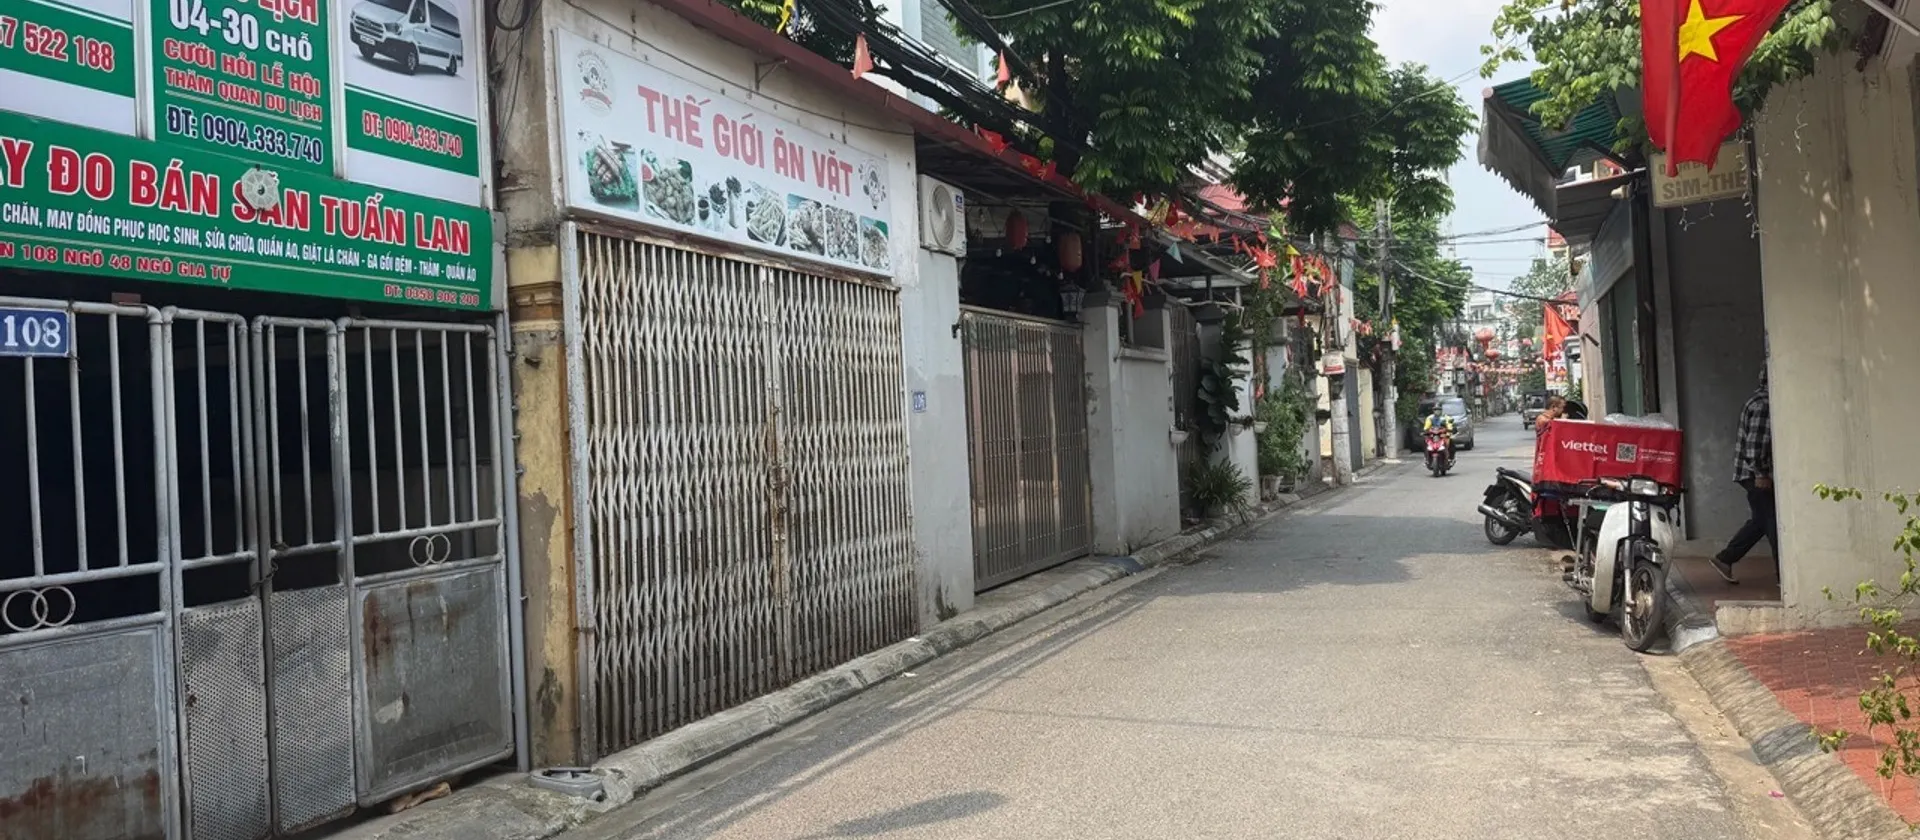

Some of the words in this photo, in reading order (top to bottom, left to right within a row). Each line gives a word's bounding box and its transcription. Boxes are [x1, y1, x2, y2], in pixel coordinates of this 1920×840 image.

[169, 0, 259, 50] 04-30
[265, 29, 313, 61] CHỖ
[258, 0, 319, 26] ỊCH
[0, 15, 18, 48] 7
[24, 21, 68, 62] 522
[73, 34, 115, 73] 188
[164, 38, 216, 70] CƯỚI
[221, 52, 257, 80] HỎI
[289, 72, 320, 99] HỘI
[164, 66, 214, 95] THĂM
[218, 80, 261, 107] QUAN
[265, 92, 286, 113] DU
[289, 98, 322, 121] LỊCH
[167, 104, 198, 137] ĐT:
[203, 113, 323, 164] 0904.333.740
[362, 109, 382, 138] ĐT:
[384, 116, 463, 158] 0904.333.740
[637, 84, 711, 149] THẾ
[712, 112, 765, 169] GIỚI
[773, 128, 805, 182] ĂN
[811, 148, 854, 201] VẶT
[0, 136, 34, 188] Y
[47, 145, 114, 200] ĐO
[129, 158, 220, 218] BÁN
[320, 192, 406, 246] TUẤN
[414, 212, 471, 256] LAN
[3, 201, 43, 228] CHĂN,
[46, 208, 74, 231] MAY
[114, 217, 145, 243] PHỤC
[148, 222, 170, 246] HỌC
[173, 226, 202, 248] SINH,
[205, 226, 226, 250] SỬA
[22, 244, 58, 263] 108
[109, 254, 131, 271] 48
[136, 256, 173, 275] NGÔ
[177, 261, 206, 279] GIA
[211, 265, 232, 283] TỰ
[3, 314, 61, 348] 108
